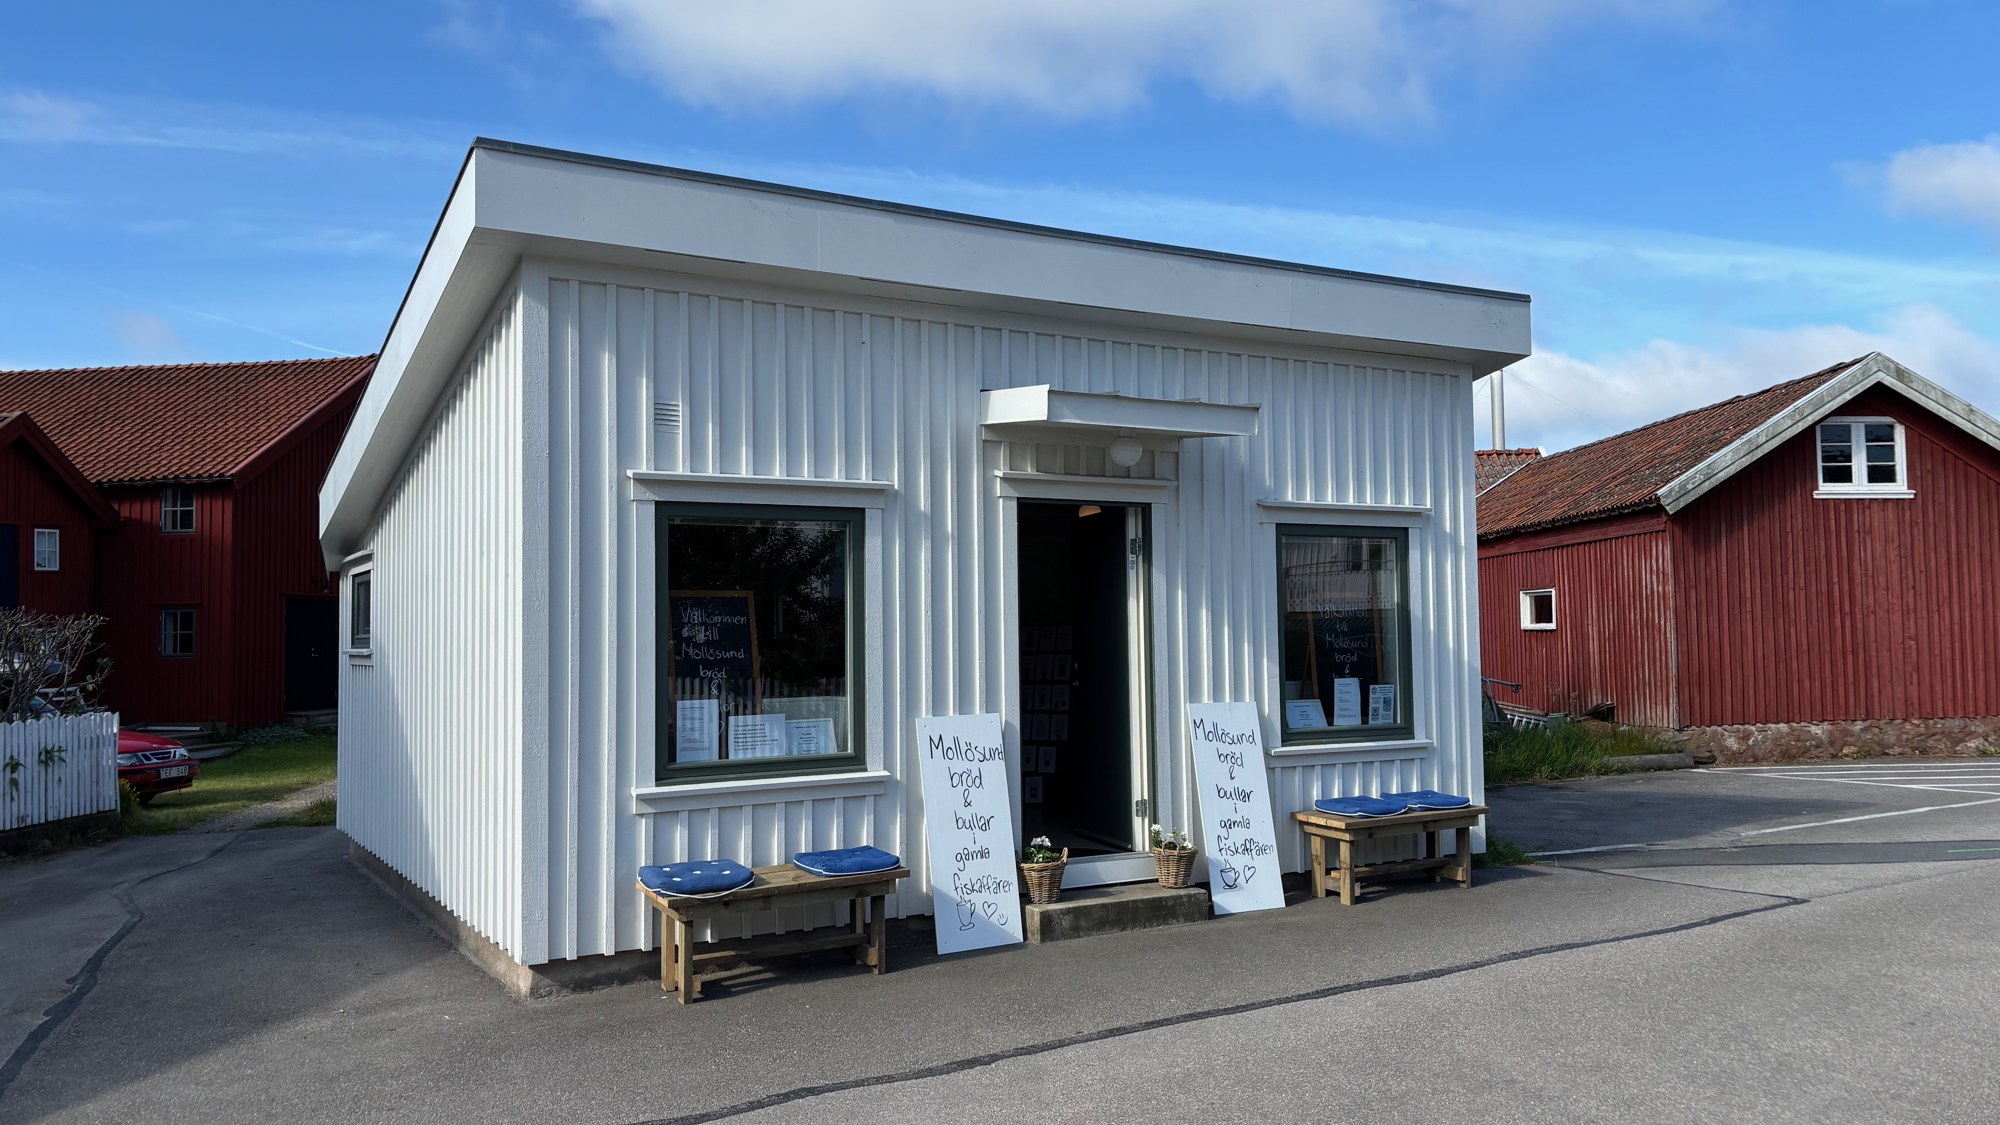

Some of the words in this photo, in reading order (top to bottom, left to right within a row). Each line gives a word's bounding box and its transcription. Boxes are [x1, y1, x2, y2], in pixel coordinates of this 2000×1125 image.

[680, 605, 747, 625] Välkommen
[681, 641, 745, 660] Mollösund
[1325, 633, 1368, 648] Mollösund
[1334, 652, 1358, 663] bröd
[699, 664, 727, 679] bröd
[710, 679, 720, 695] &
[1193, 718, 1257, 746] Mollösund
[929, 734, 1004, 762] Mollösund
[1216, 747, 1245, 768] bröd
[948, 766, 984, 790] bröd
[1228, 766, 1236, 780] &
[963, 788, 973, 808] &
[1216, 783, 1253, 804] bullar
[1233, 802, 1238, 814] i
[954, 810, 995, 832] bullar
[1219, 816, 1251, 840] gamla
[972, 832, 977, 846] i
[1217, 834, 1274, 861] fiskaffären
[955, 845, 991, 872] gamla
